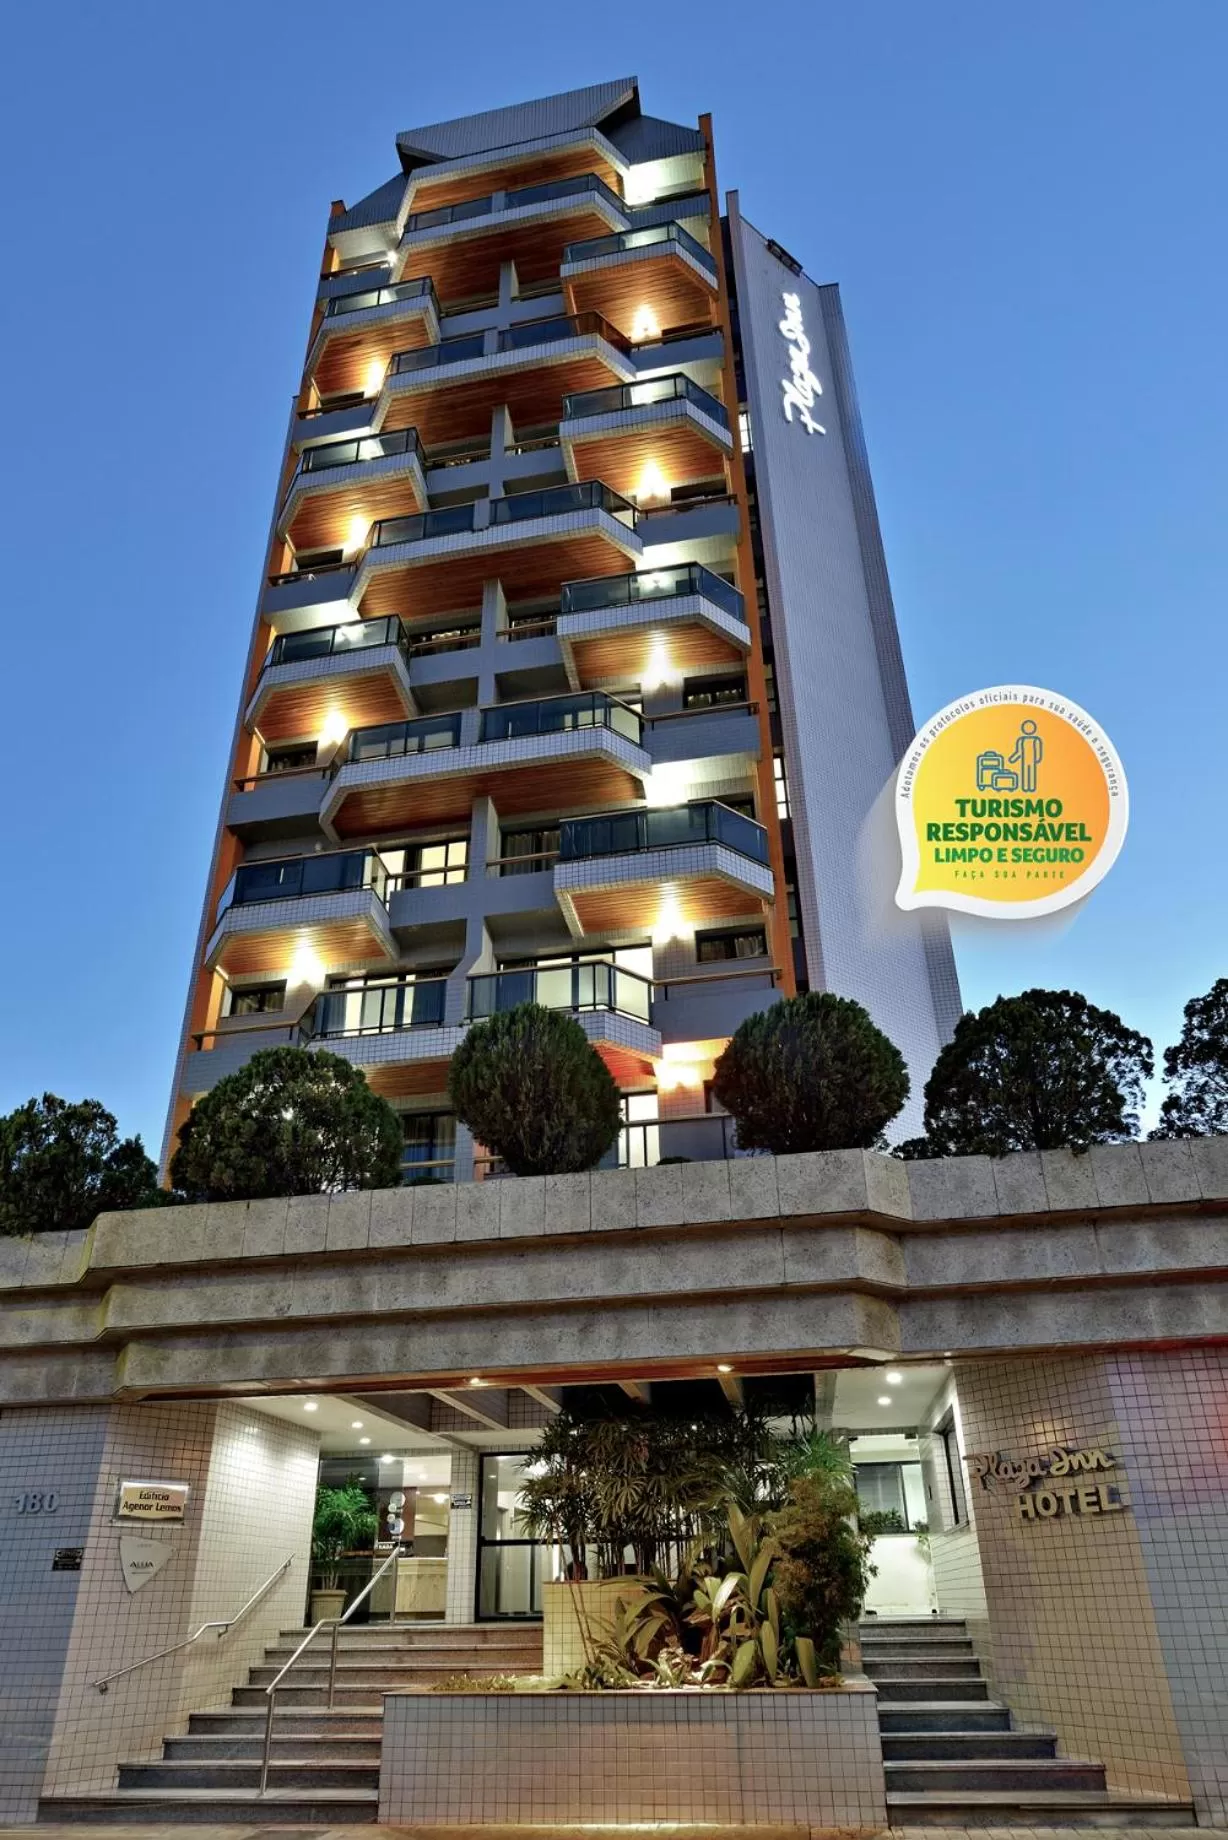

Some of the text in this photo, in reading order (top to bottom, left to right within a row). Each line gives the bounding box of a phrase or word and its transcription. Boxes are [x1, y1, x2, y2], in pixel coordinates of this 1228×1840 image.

[1049, 1447, 1115, 1476] Inn
[16, 1491, 60, 1513] 180
[1014, 1485, 1122, 1519] HOTEL
